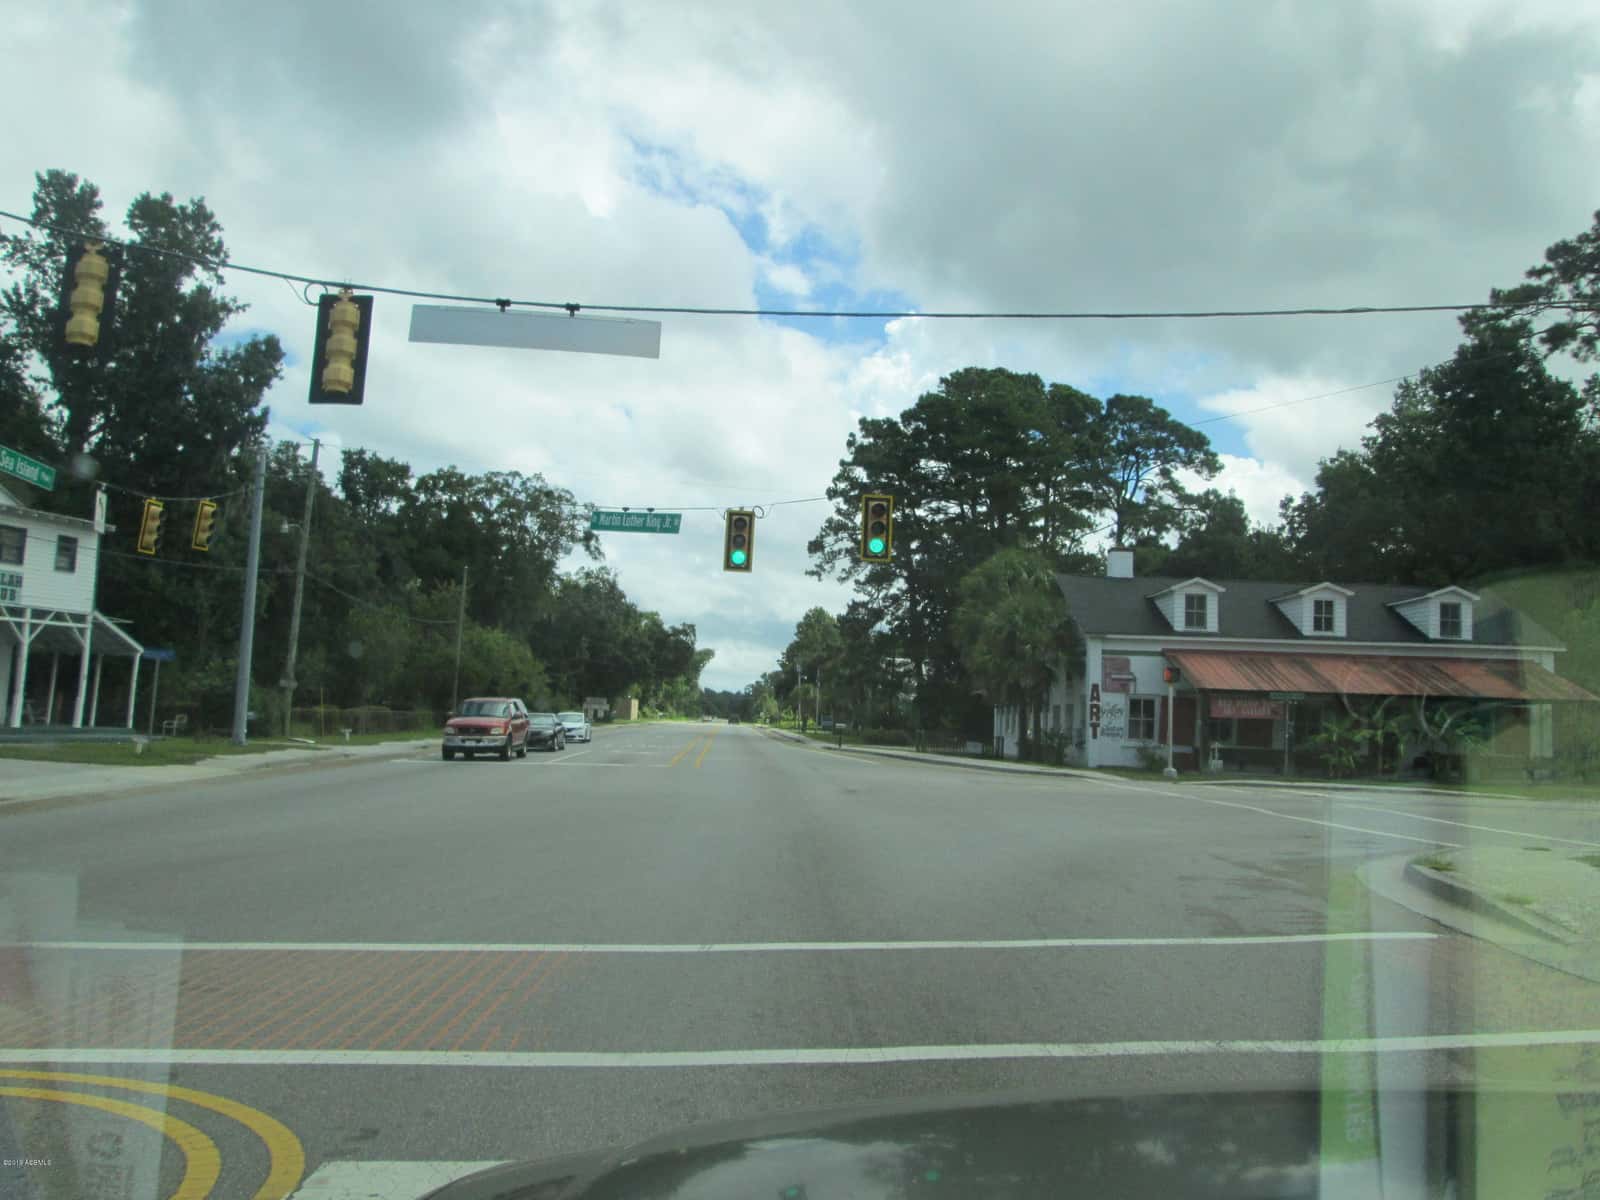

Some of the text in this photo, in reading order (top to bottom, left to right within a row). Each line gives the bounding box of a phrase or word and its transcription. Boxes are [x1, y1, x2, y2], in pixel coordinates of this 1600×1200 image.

[0, 450, 14, 471] Sea
[16, 456, 39, 481] Island
[600, 513, 621, 526] Martin
[622, 514, 645, 528] Luther
[646, 514, 661, 532] King
[1089, 683, 1101, 739] ART
